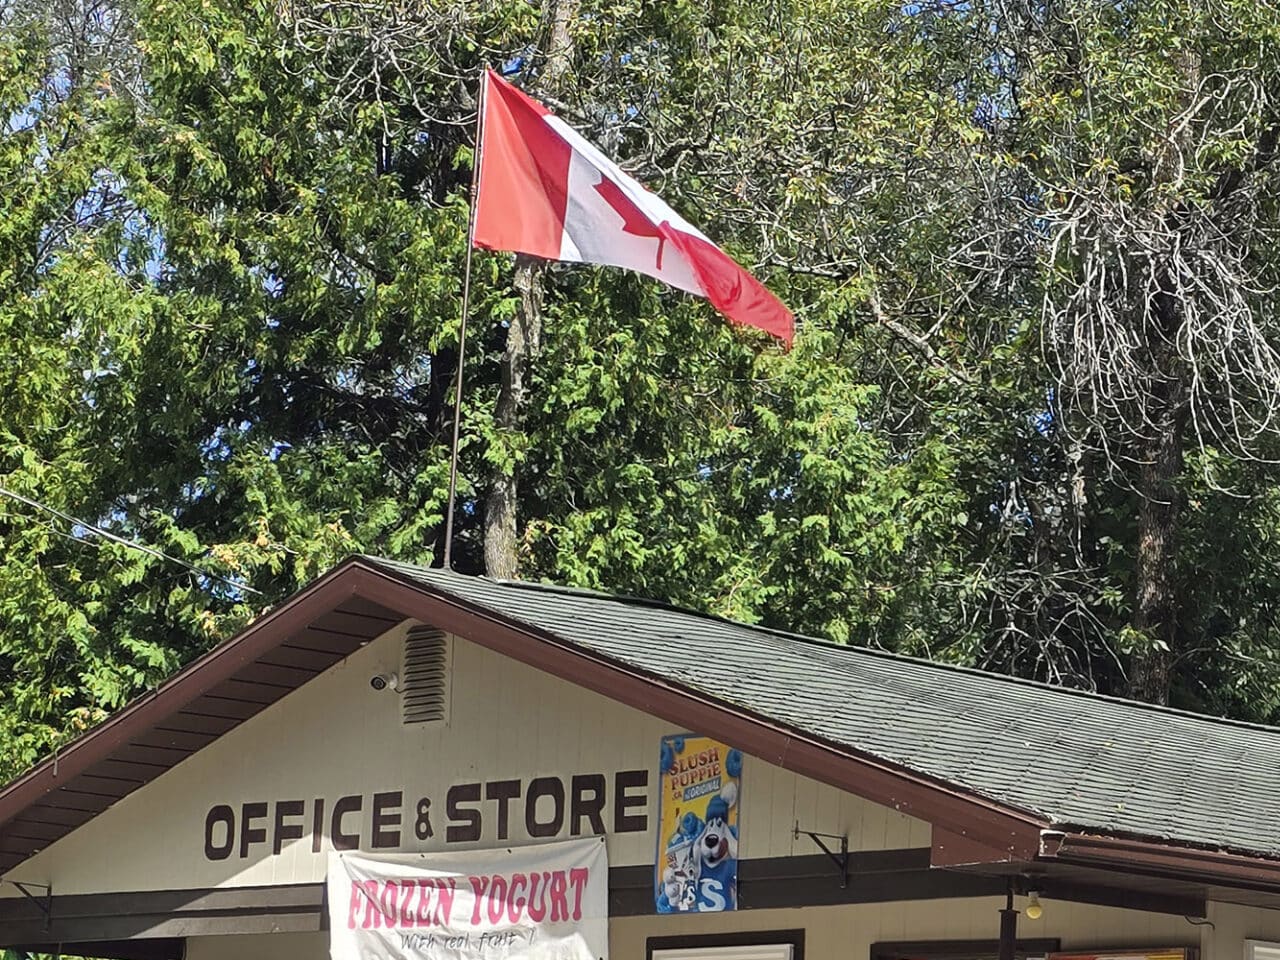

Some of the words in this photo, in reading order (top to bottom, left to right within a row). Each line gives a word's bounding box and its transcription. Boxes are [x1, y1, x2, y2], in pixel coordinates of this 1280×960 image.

[670, 747, 720, 776] SLUSH
[204, 791, 403, 861] OFFICE
[415, 797, 434, 841] &
[446, 769, 649, 844] STORE
[348, 876, 457, 930] FROZEN
[468, 868, 589, 926] YOGURT
[400, 933, 436, 950] With
[443, 932, 471, 948] real
[478, 931, 518, 952] fruit
